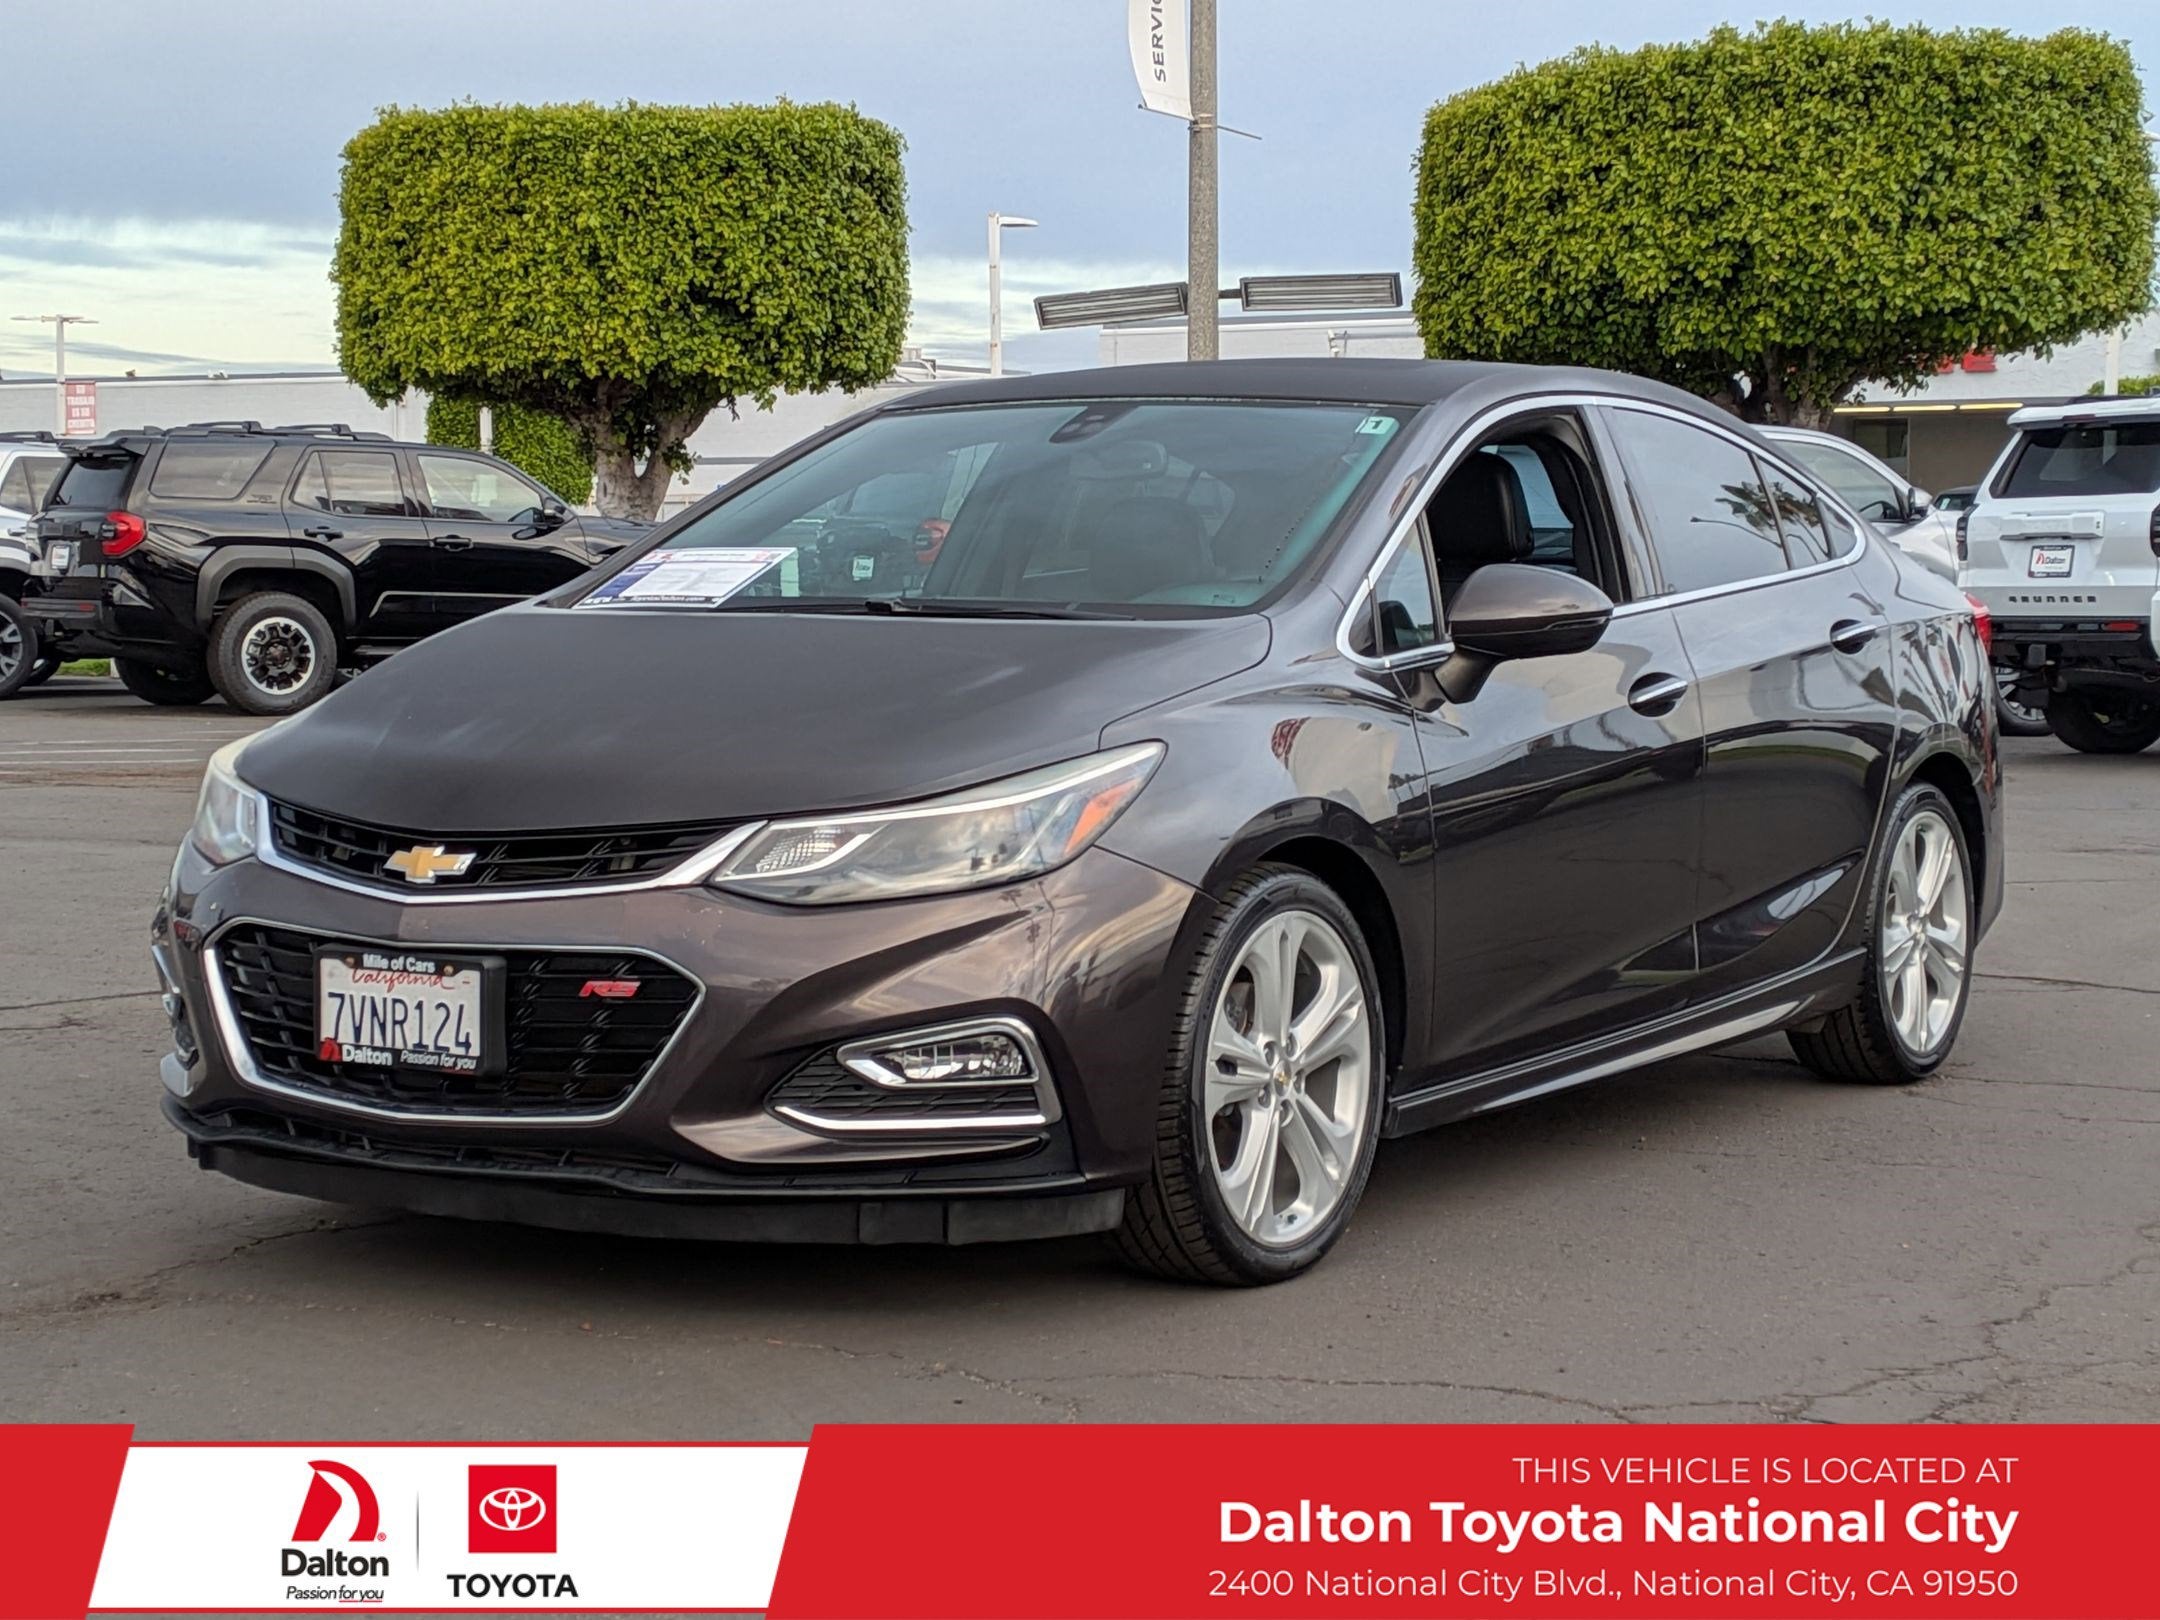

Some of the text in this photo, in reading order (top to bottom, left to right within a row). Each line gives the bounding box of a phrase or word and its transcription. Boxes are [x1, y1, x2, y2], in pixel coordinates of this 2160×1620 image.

[362, 953, 436, 973] Mile of Cars
[351, 967, 455, 993] California
[578, 981, 641, 997] RS
[328, 991, 472, 1055] 7VNR124
[342, 1044, 393, 1067] Dalton
[400, 1049, 477, 1071] Passion for you
